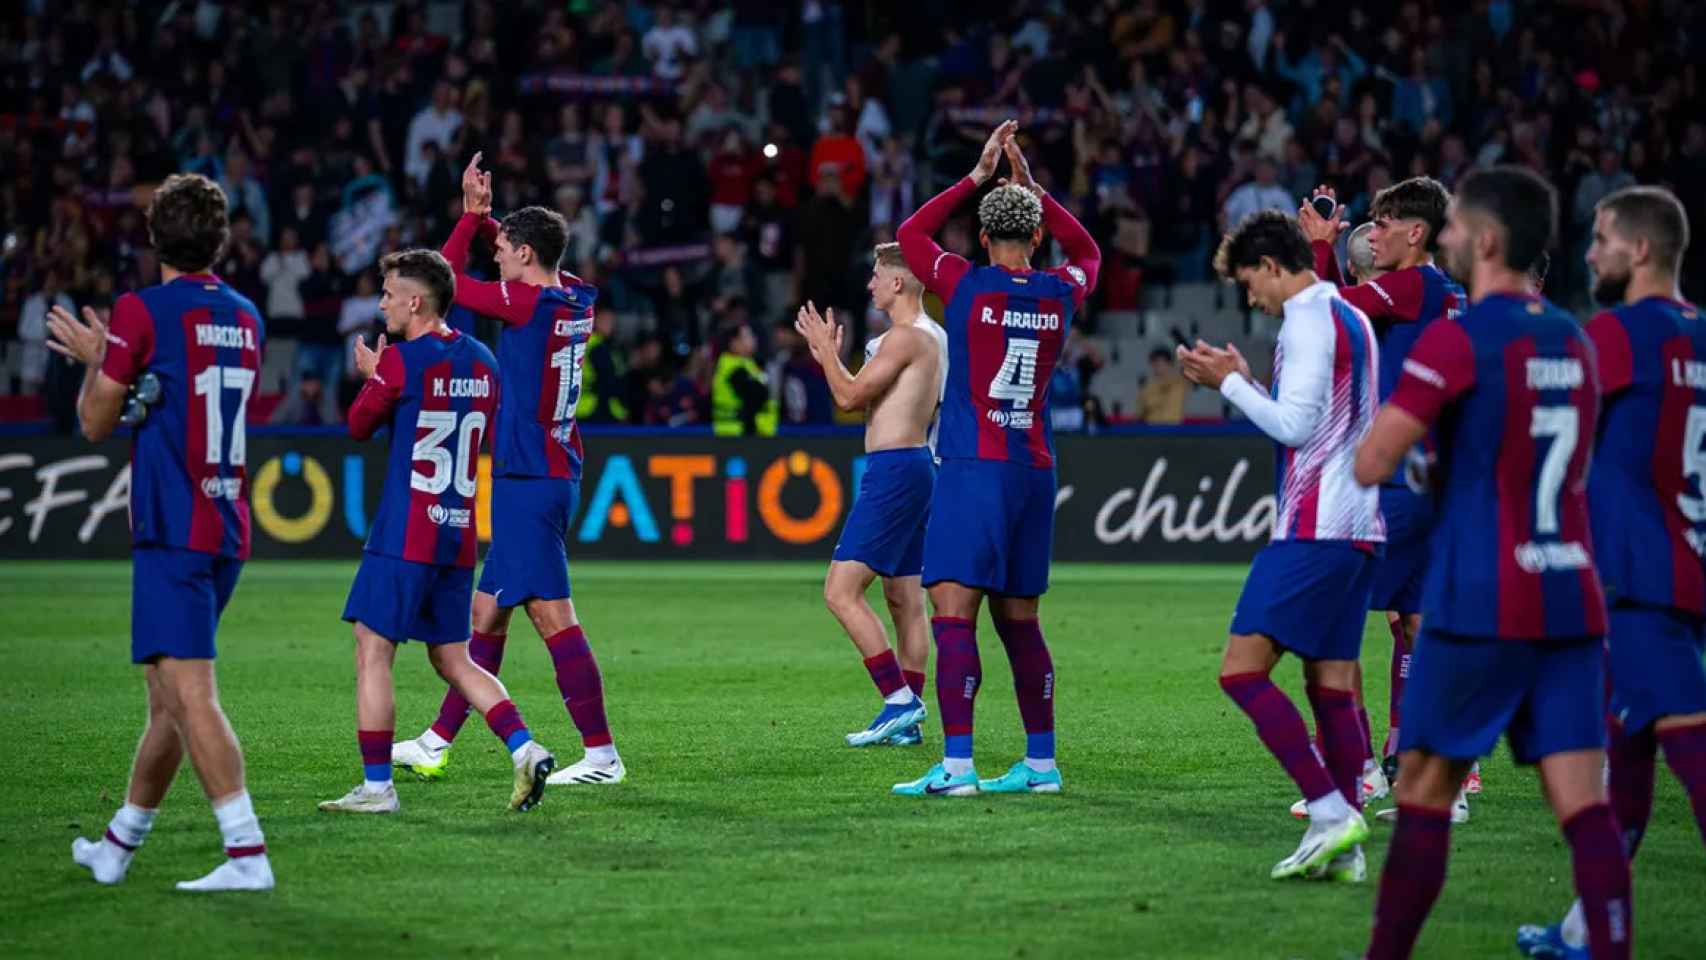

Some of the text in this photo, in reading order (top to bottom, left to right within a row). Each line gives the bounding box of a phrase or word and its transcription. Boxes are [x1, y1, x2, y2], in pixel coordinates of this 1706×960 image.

[195, 323, 243, 348] MARCOS
[981, 306, 1058, 331] R. ARAUJO
[449, 374, 489, 398] CASADÓ
[550, 342, 587, 422] 15
[988, 338, 1040, 409] 4
[194, 365, 255, 466] 17
[410, 410, 486, 498] 30
[1530, 404, 1579, 534] 7
